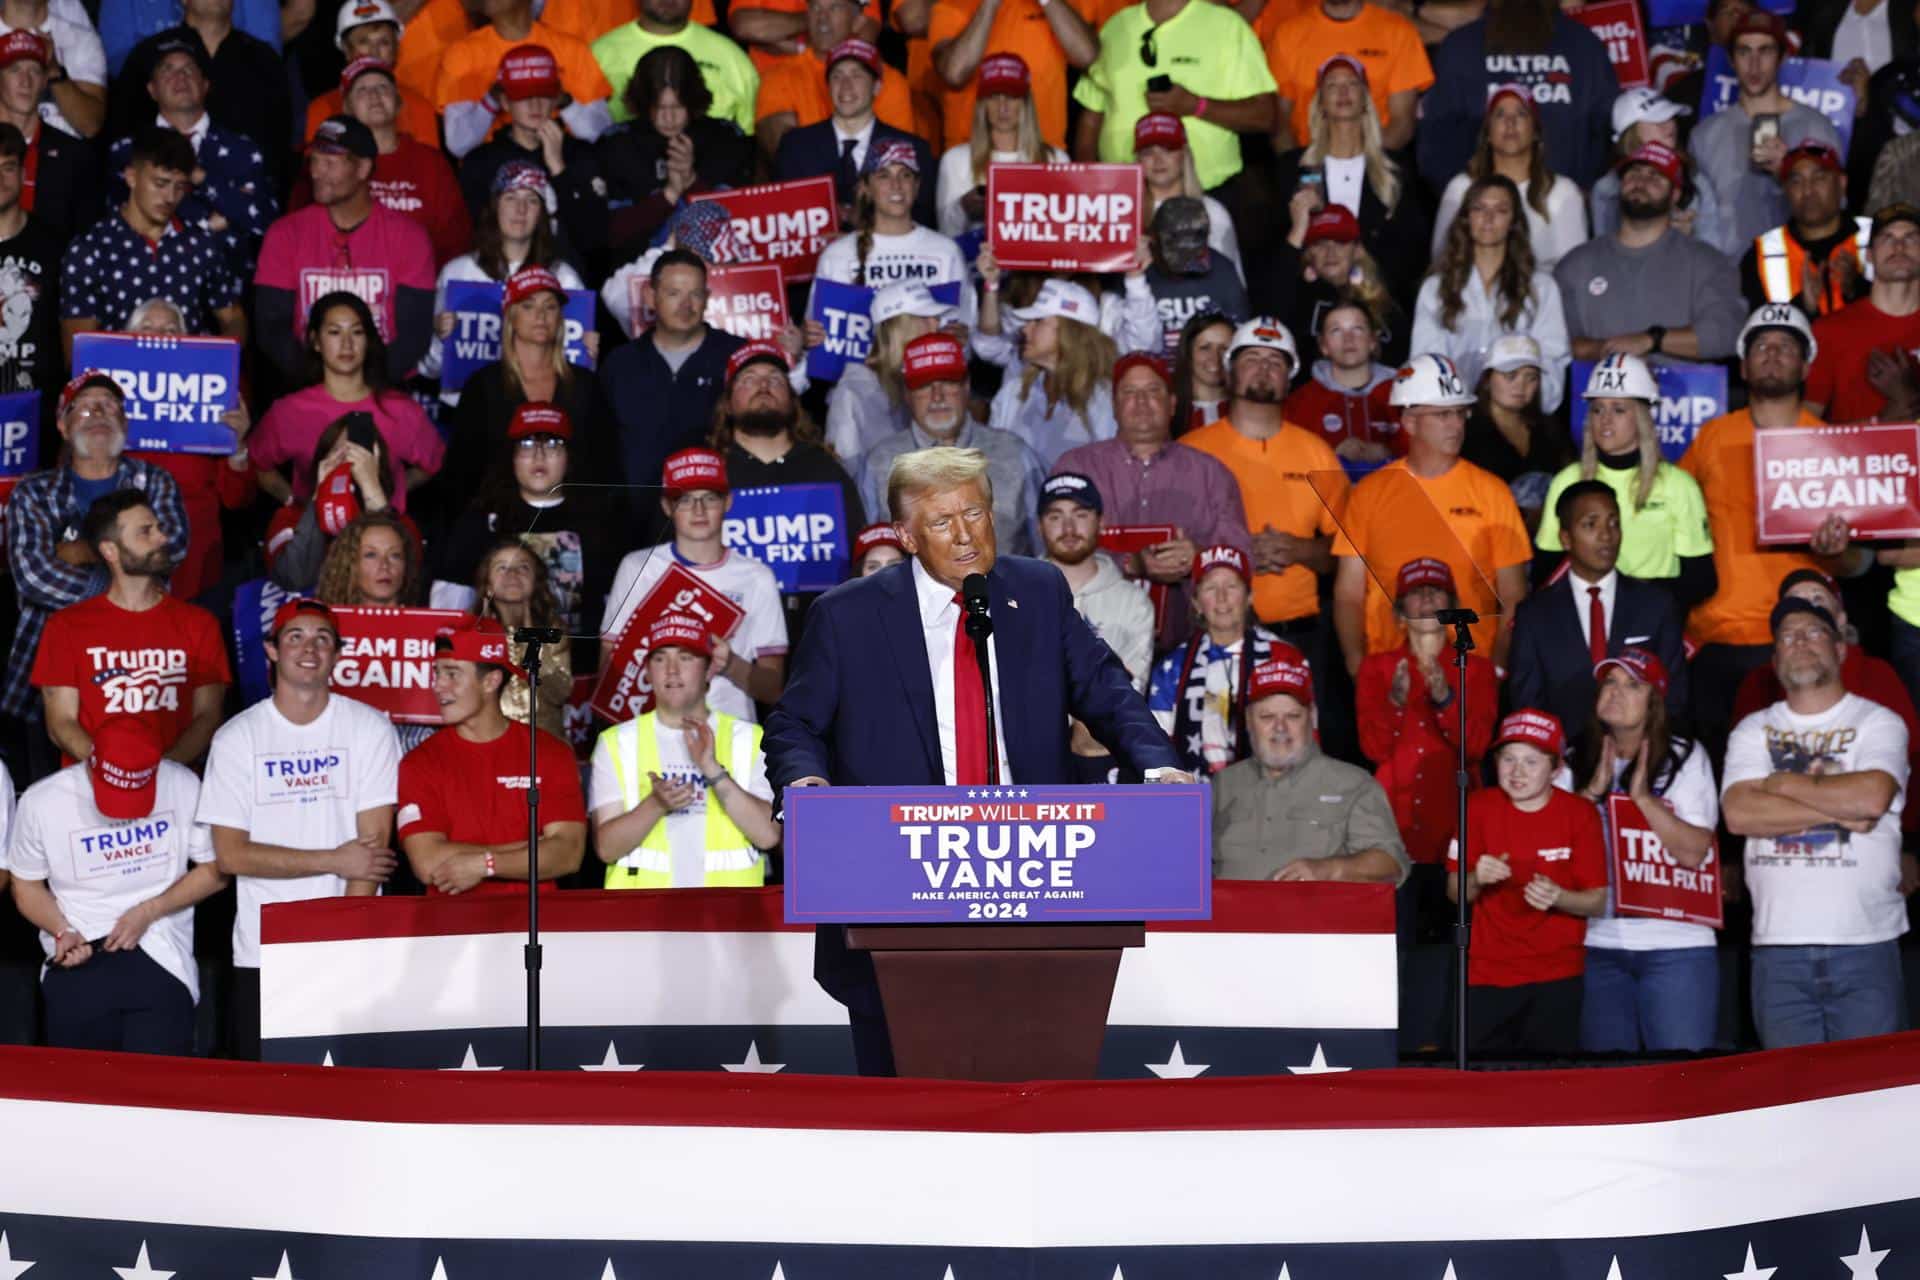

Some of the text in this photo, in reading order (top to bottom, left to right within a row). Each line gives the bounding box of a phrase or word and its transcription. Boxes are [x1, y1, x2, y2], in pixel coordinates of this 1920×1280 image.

[1485, 55, 1570, 73] ULTRA
[997, 193, 1134, 223] TRUMP
[730, 207, 829, 244] RUMP
[998, 222, 1132, 242] WILL FIX IT
[768, 240, 805, 259] FIX
[866, 263, 938, 280] RUMP
[733, 292, 780, 314] BIG,
[1761, 307, 1791, 322] ON
[455, 311, 584, 348] TRP
[455, 341, 502, 360] WIL
[84, 367, 227, 404] RUMP
[1597, 370, 1627, 391] TAX
[154, 402, 194, 422] FIX
[201, 405, 225, 424] IT
[3, 447, 27, 467] IT
[1766, 454, 1917, 479] DREAM BIG,
[1771, 476, 1907, 510] AGAIN!
[721, 513, 834, 547] RUMP
[766, 542, 835, 563] FIX IT
[340, 636, 397, 658] EAM
[86, 646, 187, 673] Trump
[609, 636, 651, 713] DREA
[103, 684, 179, 713] 2024
[263, 755, 340, 778] TRUMP
[285, 774, 329, 788] VANCE
[900, 804, 1096, 821] TRUMP WILL FIX IT
[80, 820, 169, 853] TRUMP
[900, 824, 1096, 859] TRUMP
[103, 843, 153, 862] VANCE
[922, 860, 1073, 889] VANCE
[1623, 861, 1714, 895] WILL FIX IT
[912, 890, 1084, 900] MAKE AMERICA GREAT AGAIN!
[968, 903, 1028, 919] 2024
